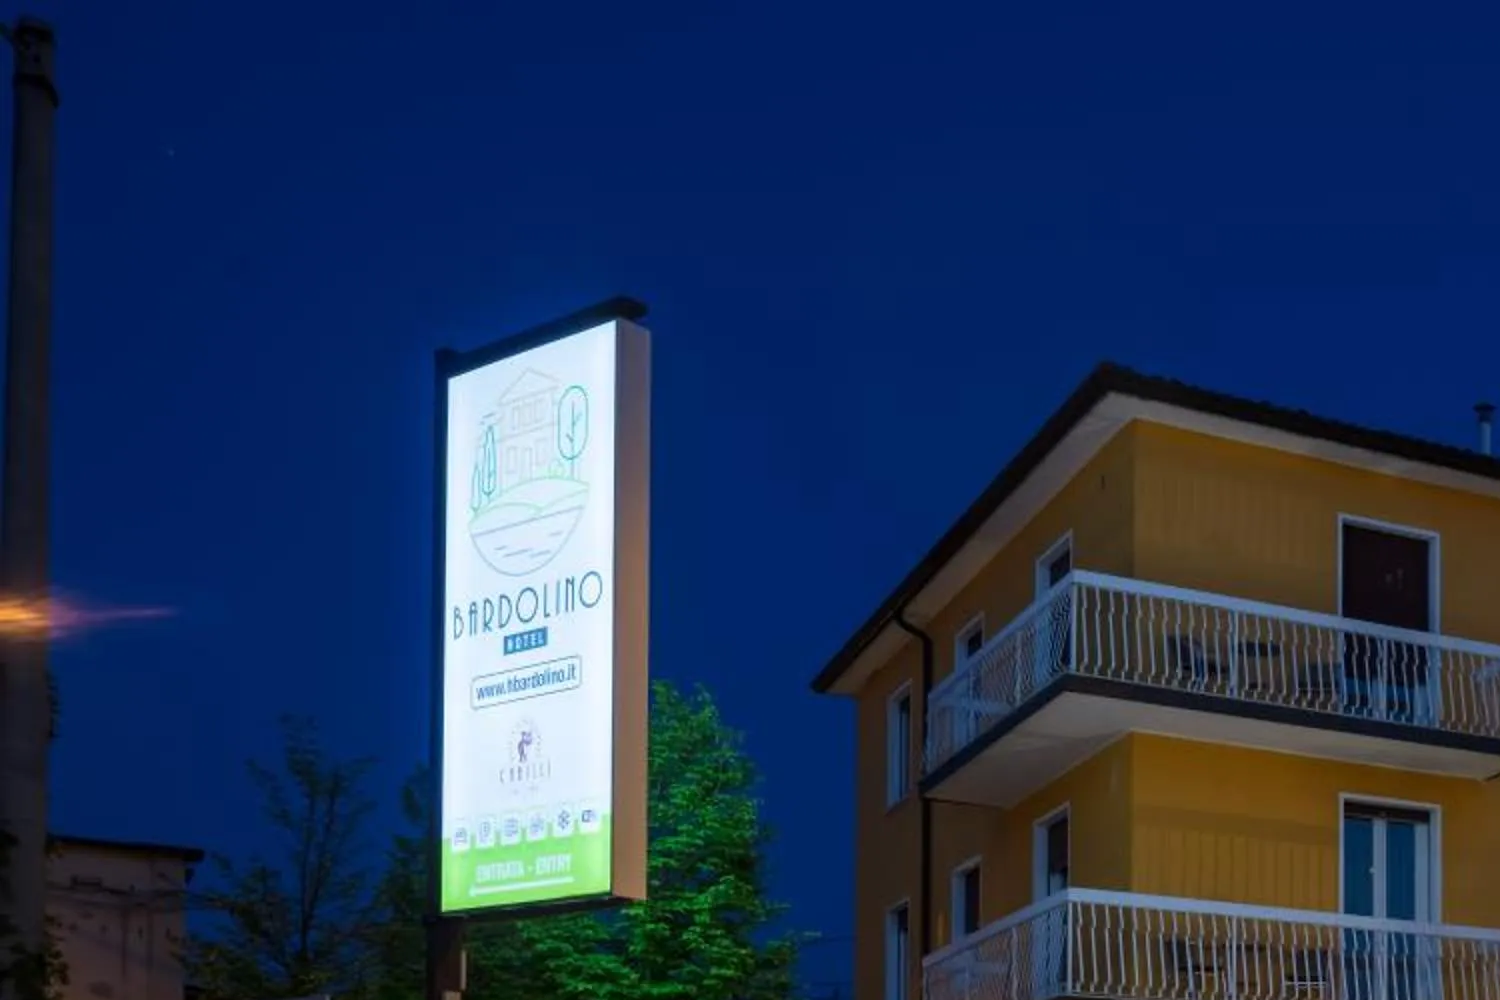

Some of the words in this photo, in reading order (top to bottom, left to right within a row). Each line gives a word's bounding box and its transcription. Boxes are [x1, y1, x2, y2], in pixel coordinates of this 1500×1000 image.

[453, 571, 603, 640] BARDOLINO
[506, 631, 545, 652] HOTEL
[476, 663, 576, 701] www.hbardolino.it
